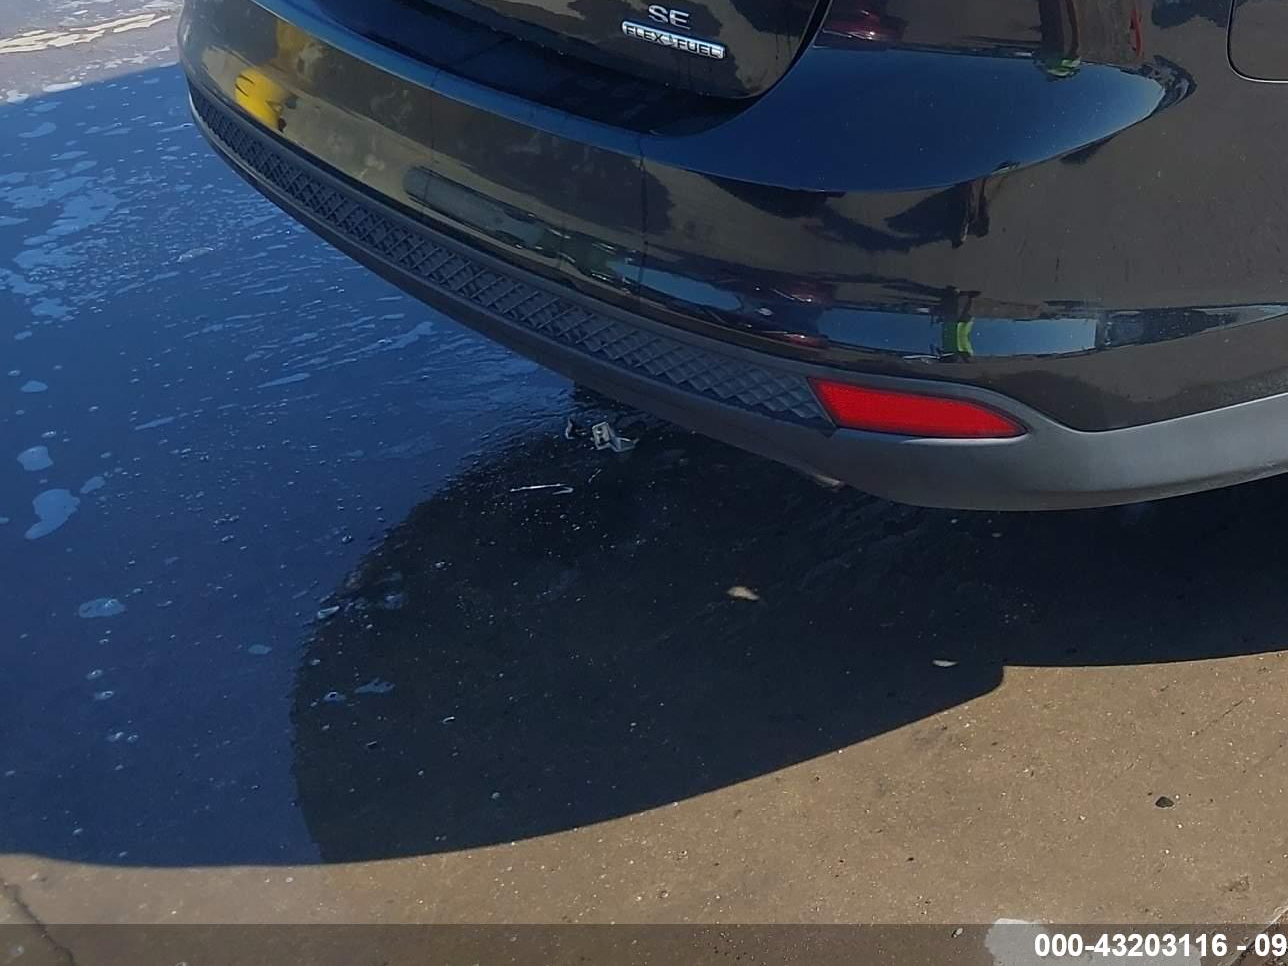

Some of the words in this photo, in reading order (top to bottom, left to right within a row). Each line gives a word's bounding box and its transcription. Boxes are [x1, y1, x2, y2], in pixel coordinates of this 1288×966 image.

[648, 4, 691, 30] SE
[626, 24, 662, 43] FLEX
[676, 38, 722, 58] FUEL
